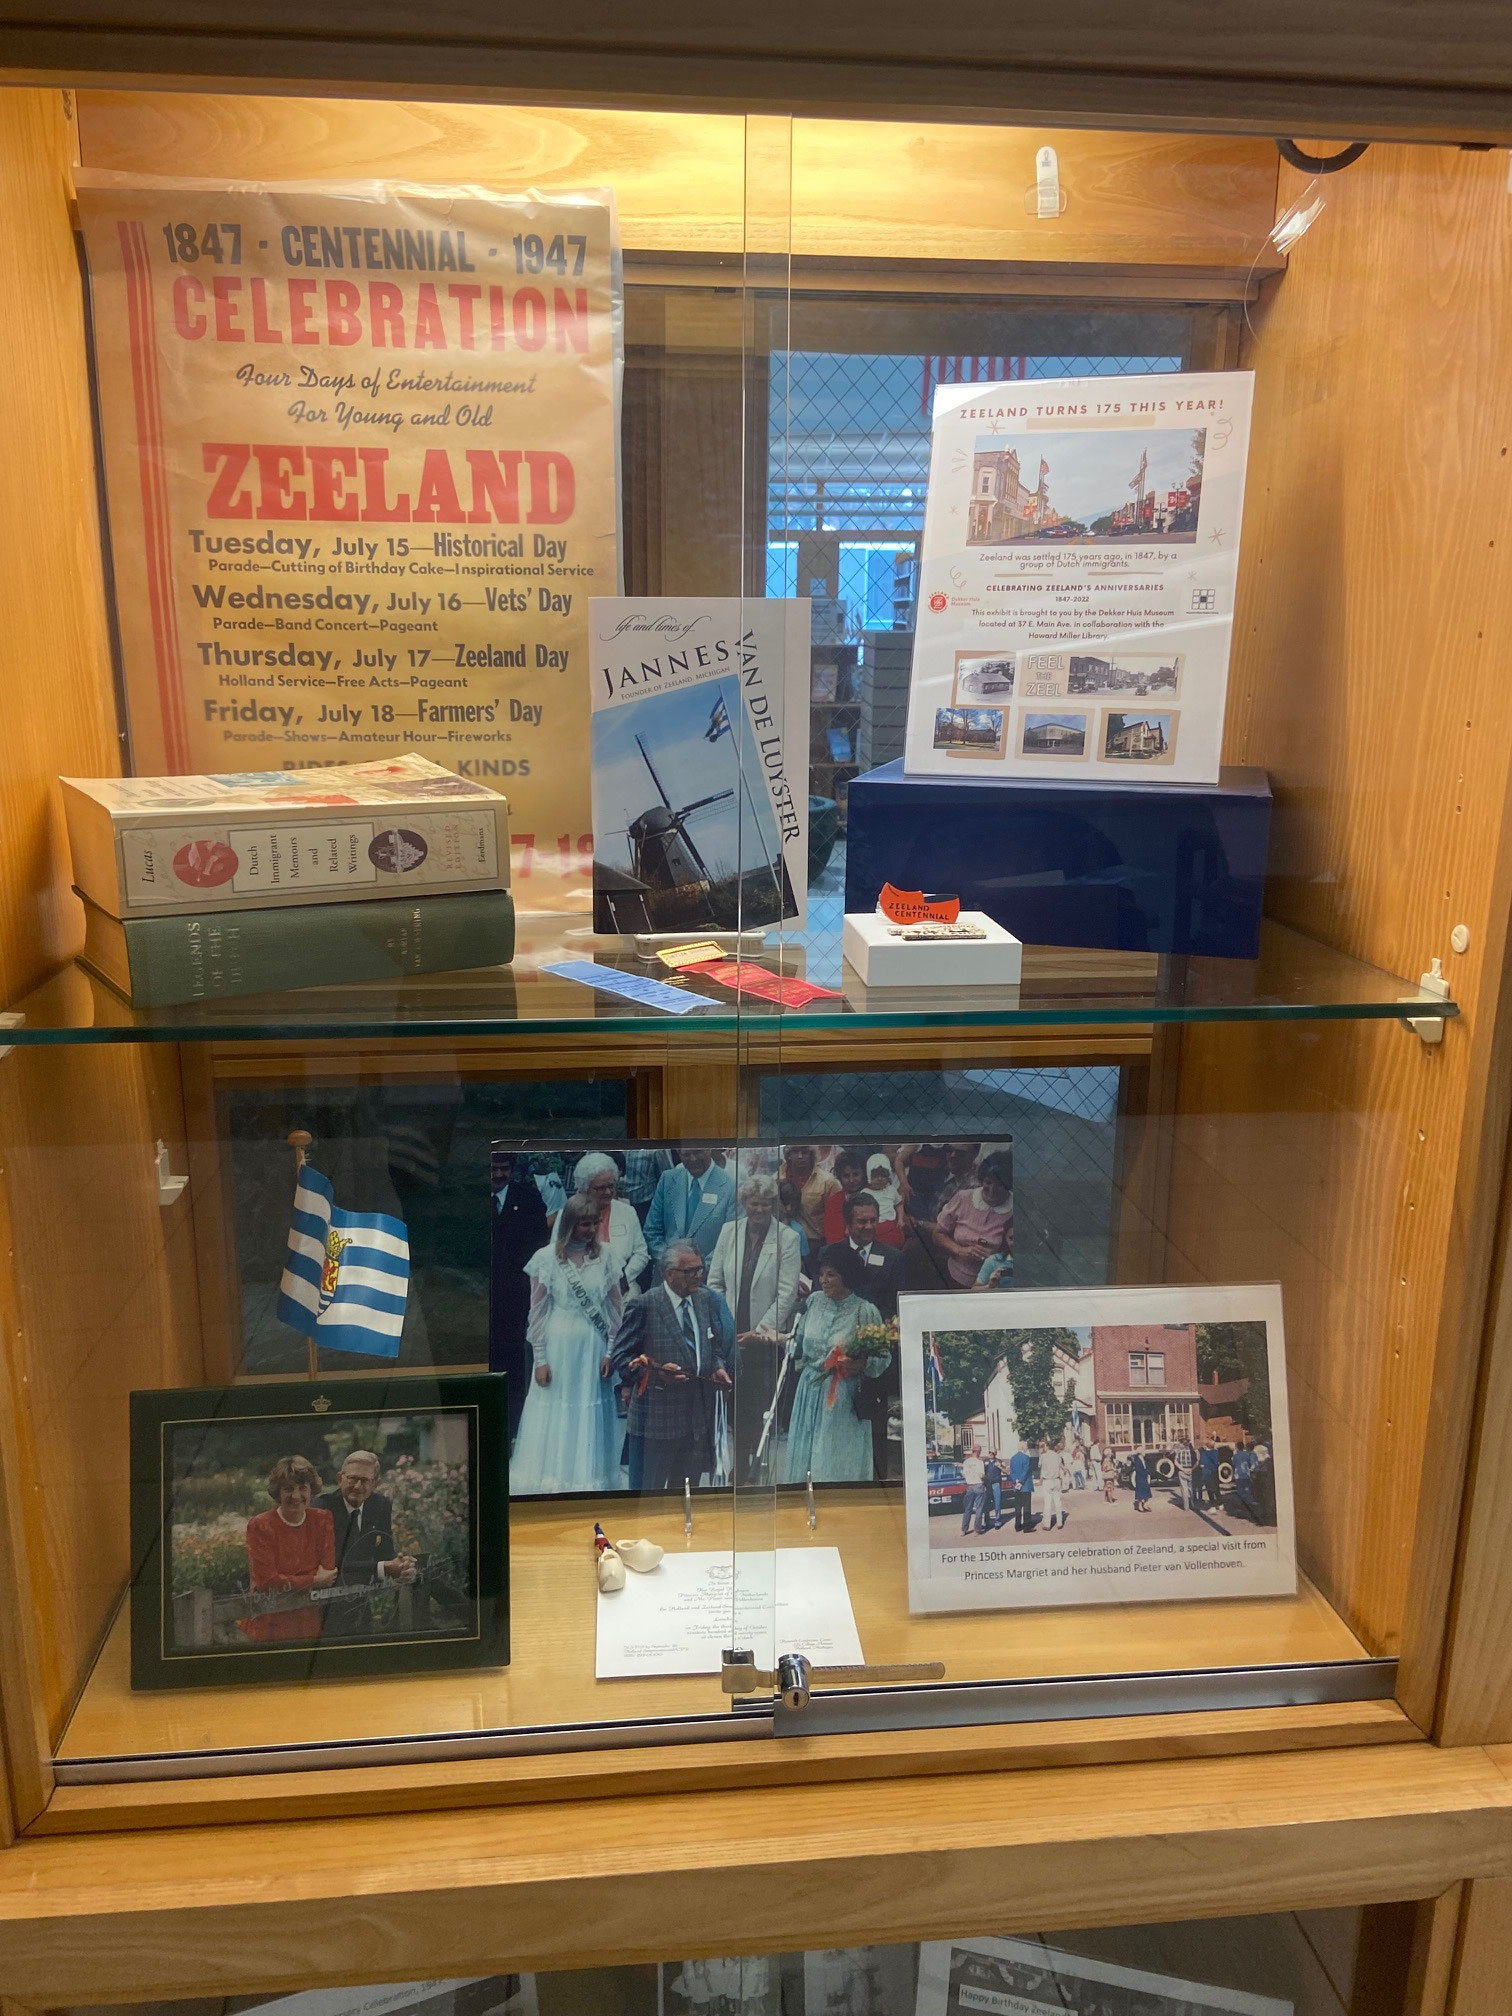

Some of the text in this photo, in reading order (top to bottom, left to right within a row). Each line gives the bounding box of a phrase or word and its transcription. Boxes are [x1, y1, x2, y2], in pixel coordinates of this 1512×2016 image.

[163, 223, 587, 276] 1847 CENTENNIAL 1947
[172, 274, 590, 354] CELEBRATION
[236, 363, 536, 397] Four Days of Entertainment
[287, 400, 494, 431] For Young and Old
[960, 399, 1224, 419] ZEELAND TURNS 175 THIS YEAR!
[202, 442, 577, 525] ZEELAND
[188, 529, 320, 560] Tuesday,
[332, 537, 378, 560] July
[533, 533, 567, 563] Day
[980, 553, 1013, 561] Zeeland
[1033, 552, 1061, 562] settled
[1079, 553, 1102, 562] years
[1104, 554, 1123, 563] ago,
[1125, 552, 1133, 560] in
[1135, 552, 1156, 561] 1847,
[1158, 551, 1169, 561] by
[328, 561, 343, 573] of
[345, 562, 405, 577] Birthday
[547, 564, 594, 576] Service
[1020, 560, 1130, 571] group of Dutch immigrants.
[192, 584, 379, 615] Wednesday,
[386, 592, 432, 615] July
[538, 588, 572, 617] Day
[1094, 584, 1164, 592] ANNIVERSARIES
[979, 620, 1007, 628] located
[1082, 620, 1133, 628] collaboration
[1020, 609, 1048, 618] brought
[1073, 609, 1083, 618] by
[197, 642, 341, 671] Thursday,
[352, 648, 397, 671] July
[535, 644, 569, 673] Day
[601, 640, 729, 699] JANNES
[1027, 655, 1065, 670] FEEL
[219, 674, 275, 687] Holland
[1025, 682, 1062, 697] ZEEL
[203, 698, 303, 727] Friday,
[317, 704, 362, 727] July
[509, 698, 543, 727] Day
[734, 628, 801, 845] VAN DE LUYSTER
[457, 759, 531, 777] KINDS
[270, 834, 282, 884] Immigrant
[290, 837, 300, 879] Memoirs
[308, 848, 319, 866] and
[327, 838, 339, 872] Related
[348, 834, 360, 874] Writings
[478, 827, 487, 863] Eerdmans
[141, 850, 155, 884] Lucas
[248, 845, 259, 876] Dutch
[889, 903, 929, 912] ZEELAND
[895, 910, 949, 920] CENTENNIAL
[942, 1554, 957, 1563] For
[960, 1553, 976, 1562] the
[979, 1551, 1007, 1562] 150th
[1010, 1549, 1065, 1561] anniversary
[1068, 1546, 1122, 1557] celebration
[1124, 1545, 1134, 1554] of
[1136, 1544, 1176, 1555] Zeeland,
[1187, 1542, 1219, 1554] special
[1222, 1541, 1241, 1550] visit
[1244, 1540, 1266, 1549] from
[964, 1560, 1245, 1580] Princess Margriet and her husband Pieter van Vollenhoven.
[961, 1989, 990, 2005] Happy
[992, 1996, 1029, 2014] Birthday
